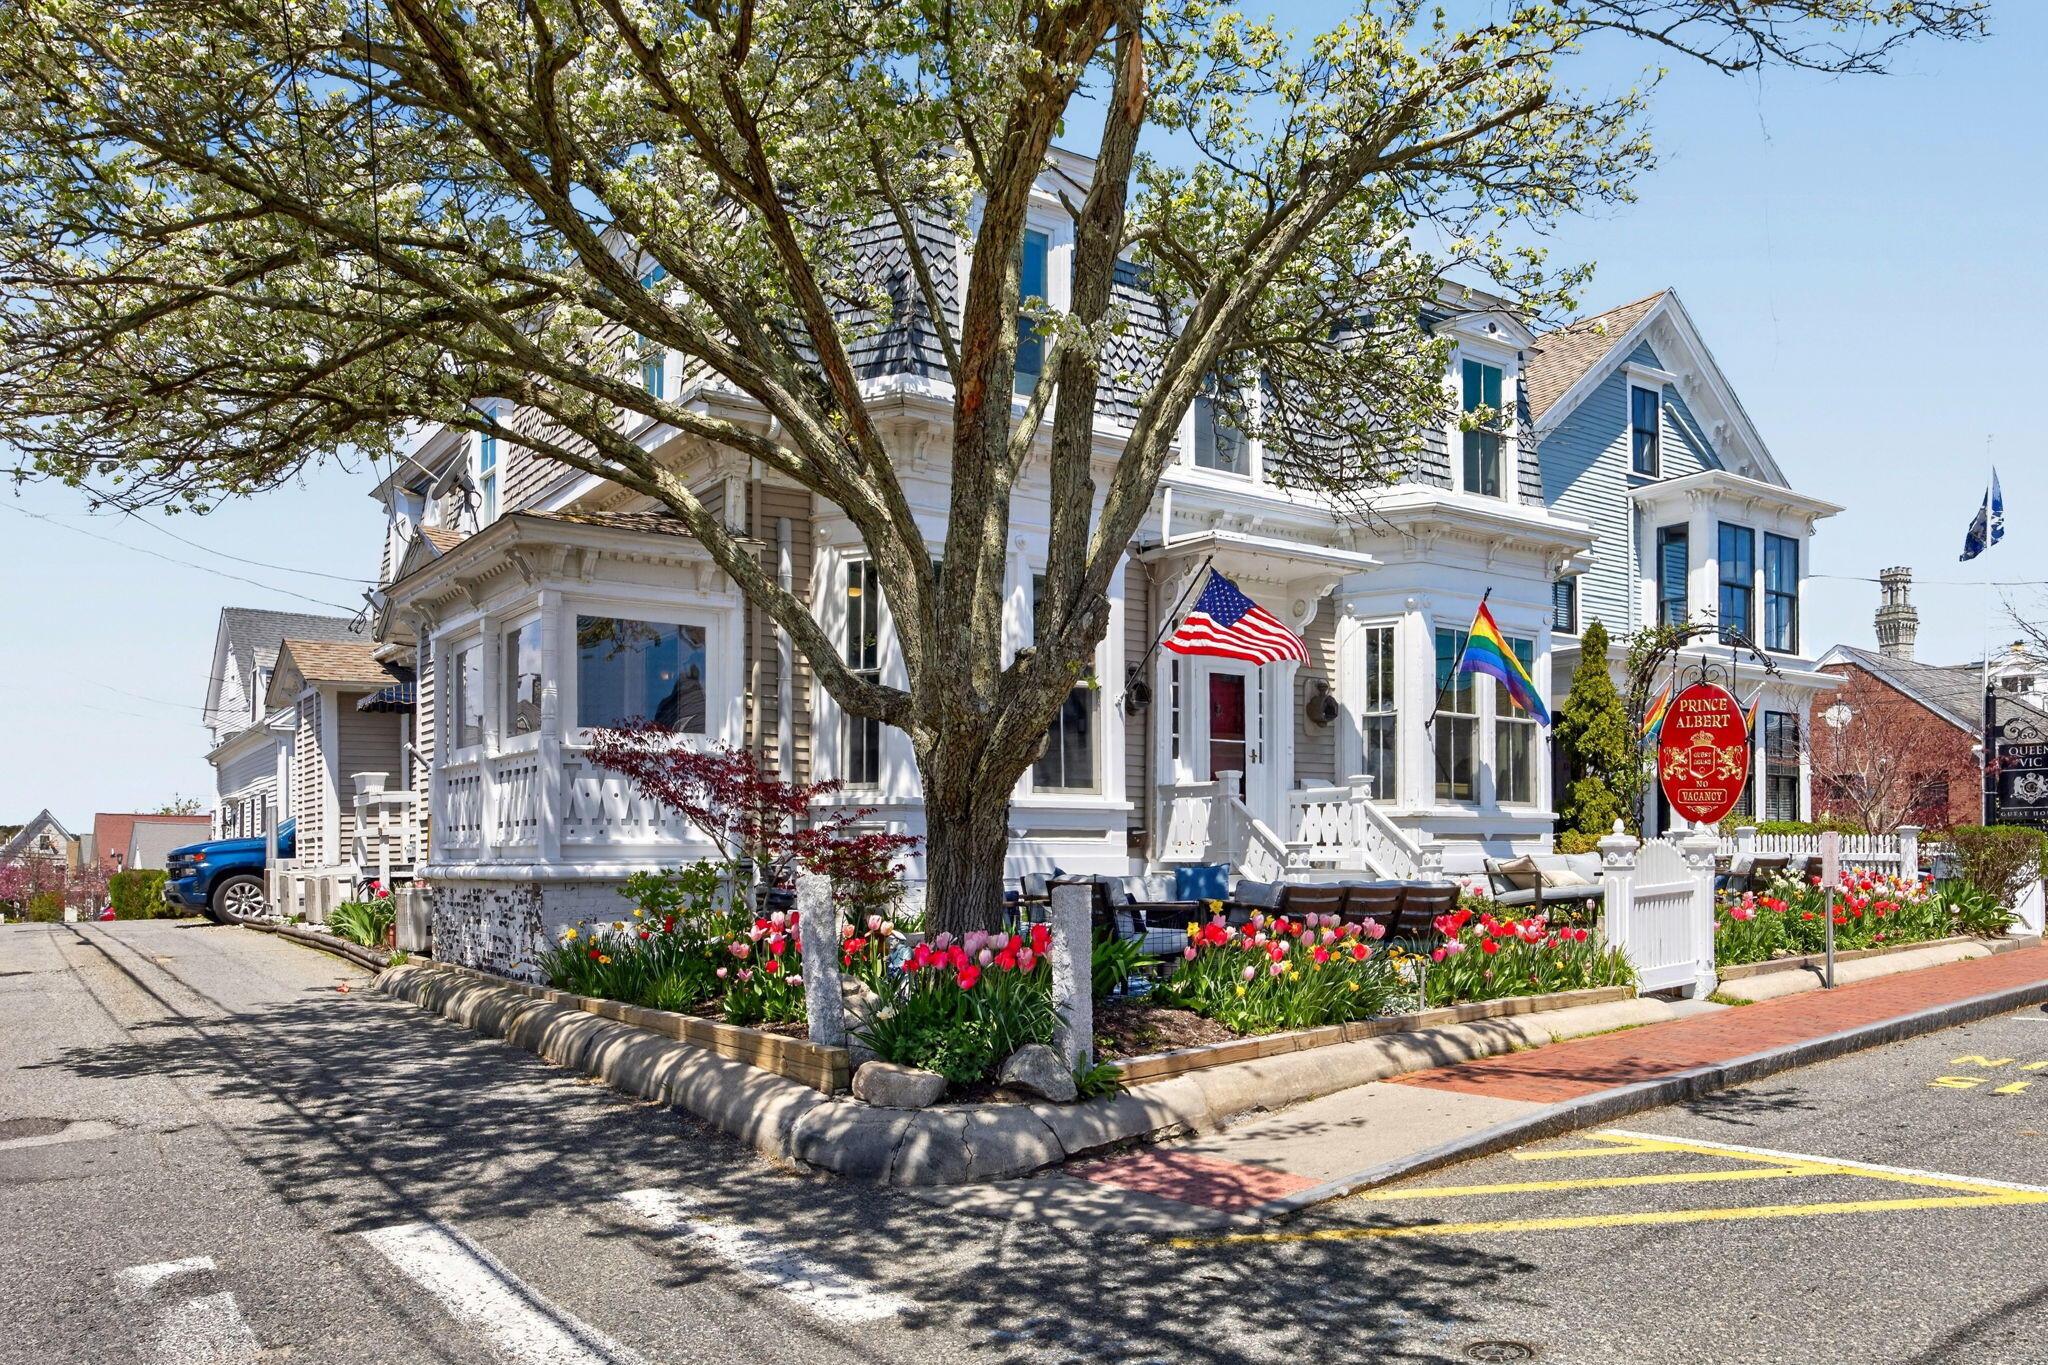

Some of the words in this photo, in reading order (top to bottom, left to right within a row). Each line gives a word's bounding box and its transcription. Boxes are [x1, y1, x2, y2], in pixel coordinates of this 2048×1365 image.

[1679, 699, 1727, 712] PRINCE
[1676, 714, 1730, 728] ALBERT
[2019, 757, 2043, 767] VIC
[1696, 780, 1709, 788] NO
[1682, 791, 1722, 802] VACANCY
